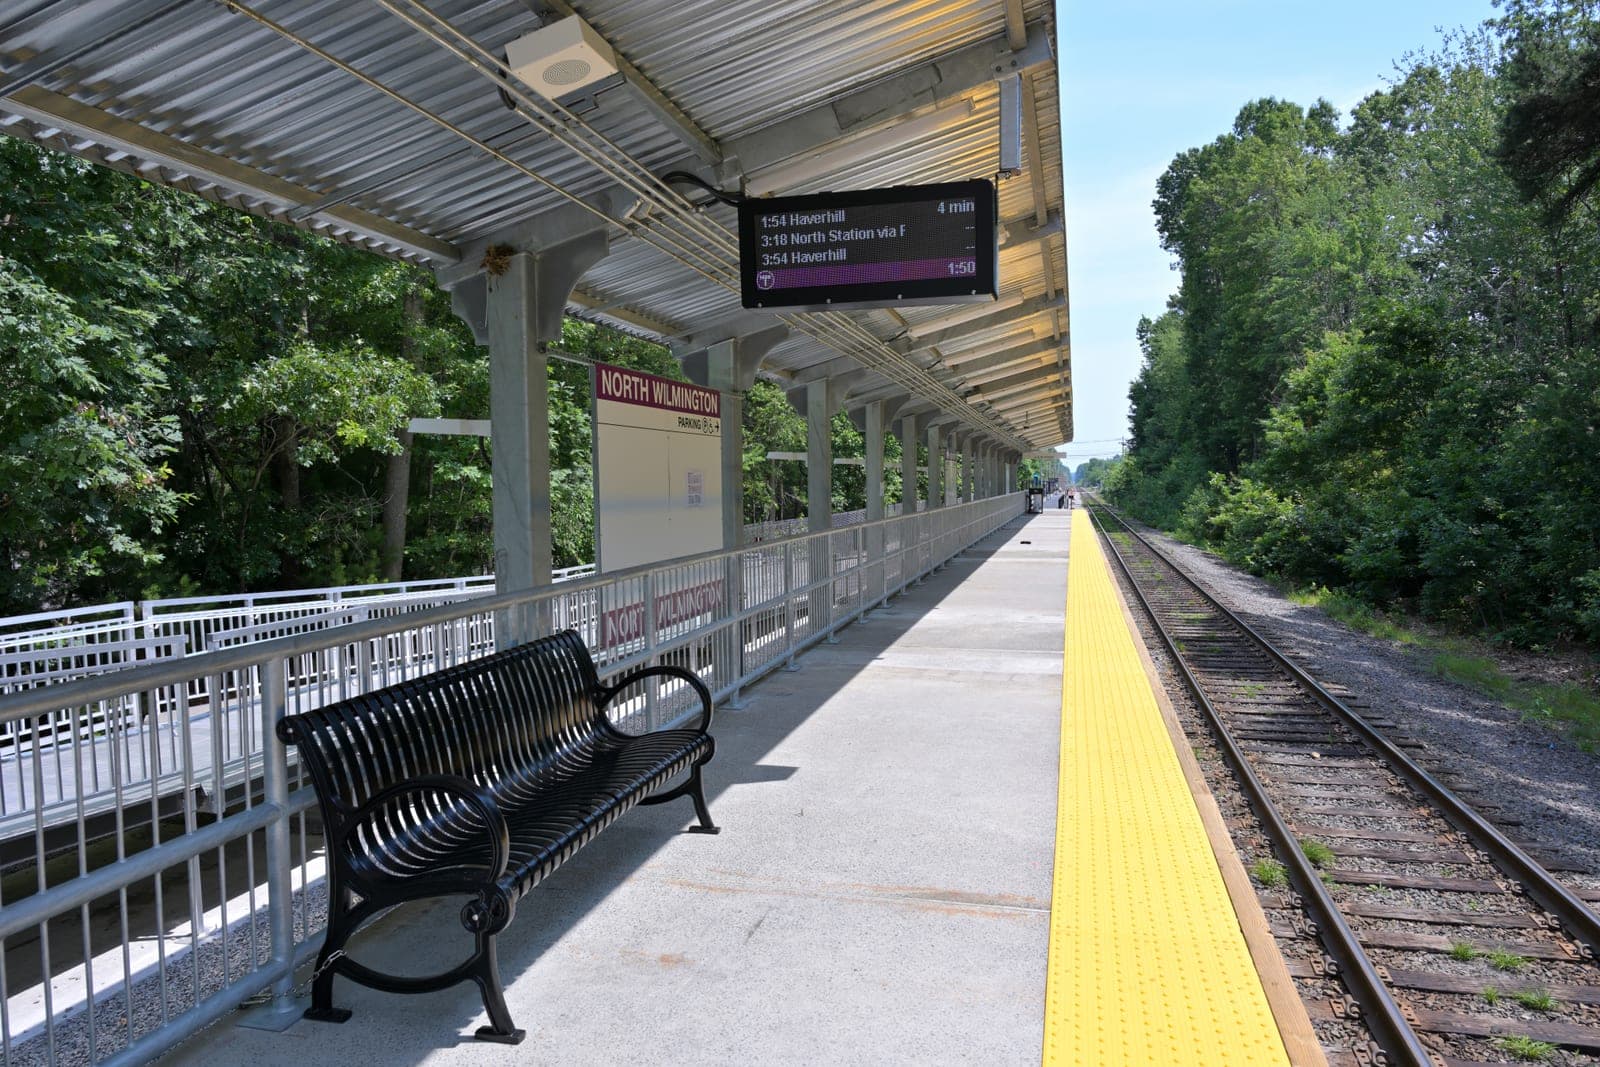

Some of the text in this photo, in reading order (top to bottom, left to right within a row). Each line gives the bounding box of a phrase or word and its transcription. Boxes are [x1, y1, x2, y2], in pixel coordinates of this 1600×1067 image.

[937, 200, 975, 214] 4 min
[761, 210, 845, 228] 1:54 Haverhill
[761, 234, 788, 247] 3:18
[790, 230, 826, 245] North
[829, 228, 874, 243] Station
[878, 226, 896, 239] via
[762, 248, 847, 265] 3:54 Haverhill
[947, 261, 976, 275] 1:50
[601, 369, 718, 414] NORTH WILMINGTON
[678, 416, 702, 430] PARKING
